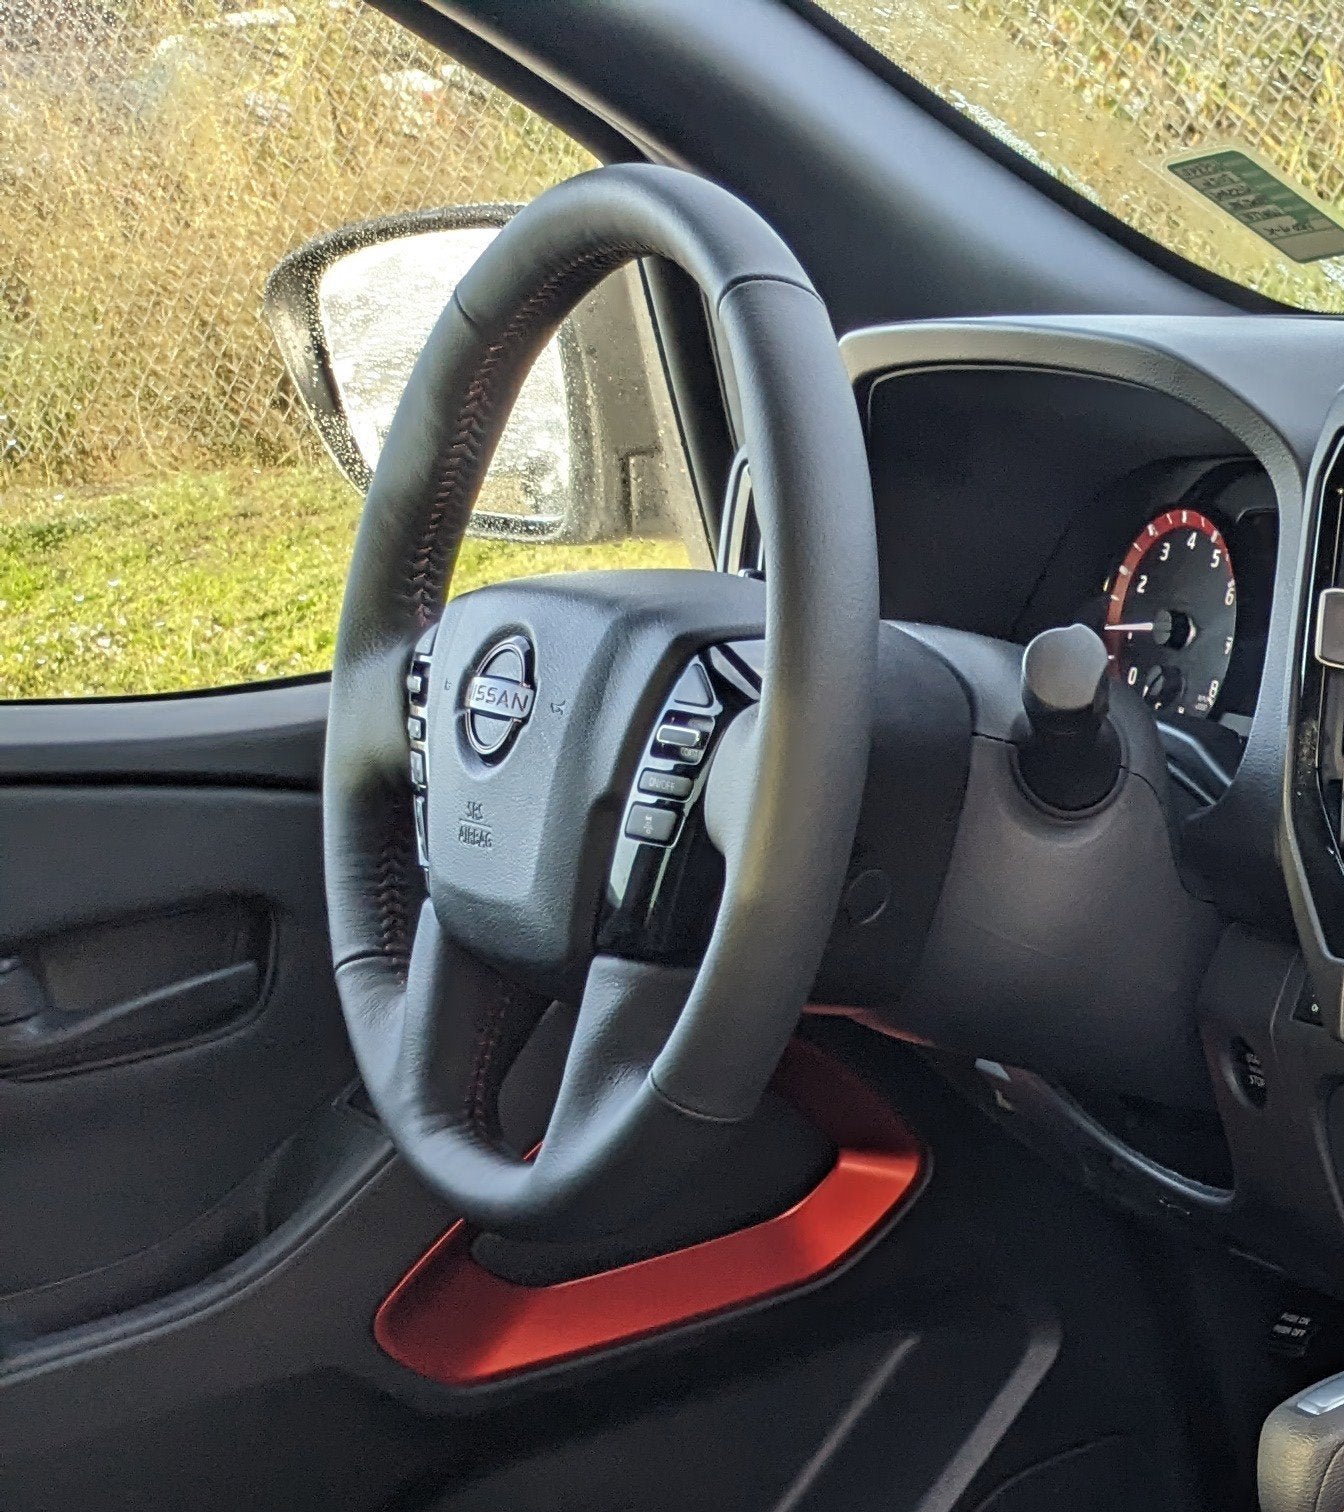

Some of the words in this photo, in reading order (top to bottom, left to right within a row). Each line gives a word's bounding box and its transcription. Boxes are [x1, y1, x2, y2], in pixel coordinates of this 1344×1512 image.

[1187, 532, 1197, 550] 4
[1160, 542, 1170, 561] 3
[1210, 549, 1221, 569] 5
[1137, 574, 1148, 594] 2
[1225, 587, 1235, 606] 6
[1127, 666, 1138, 685] 0
